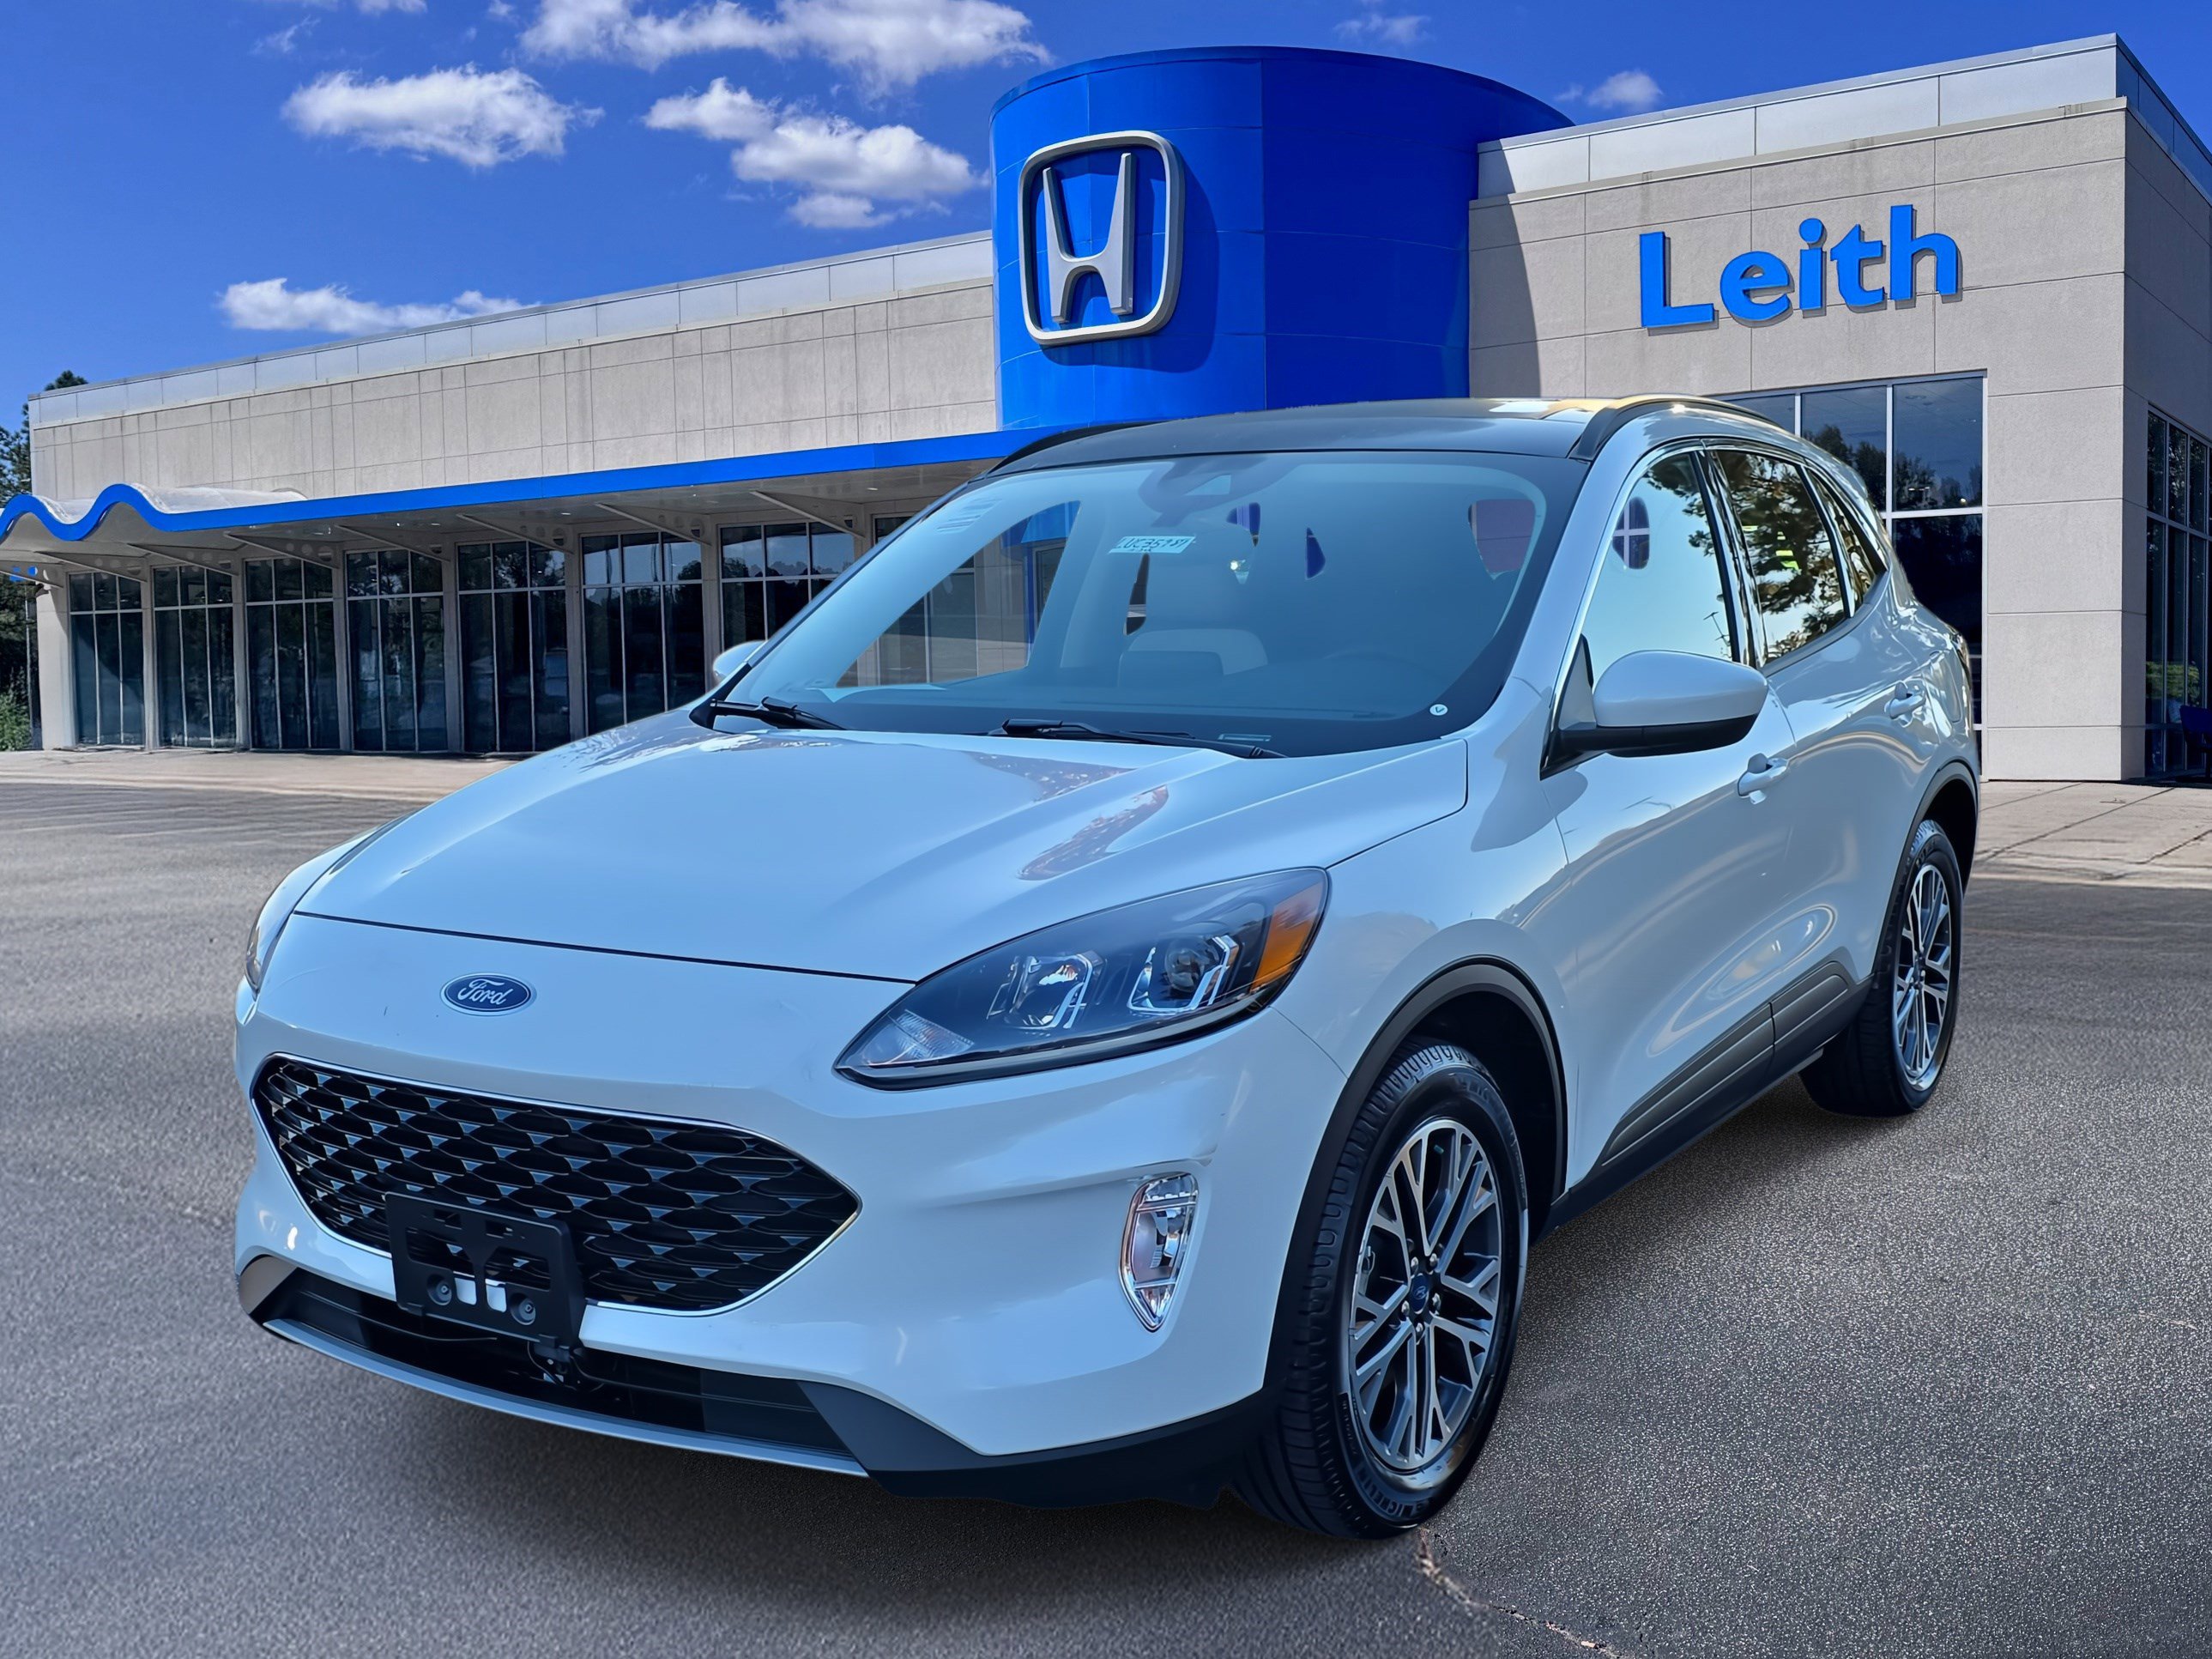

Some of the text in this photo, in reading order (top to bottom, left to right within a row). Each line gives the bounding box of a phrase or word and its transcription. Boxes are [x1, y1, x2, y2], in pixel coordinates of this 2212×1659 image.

[1640, 204, 1960, 329] Leith
[457, 978, 513, 1005] Ford
[1357, 1467, 1415, 1518] MICHELIN
